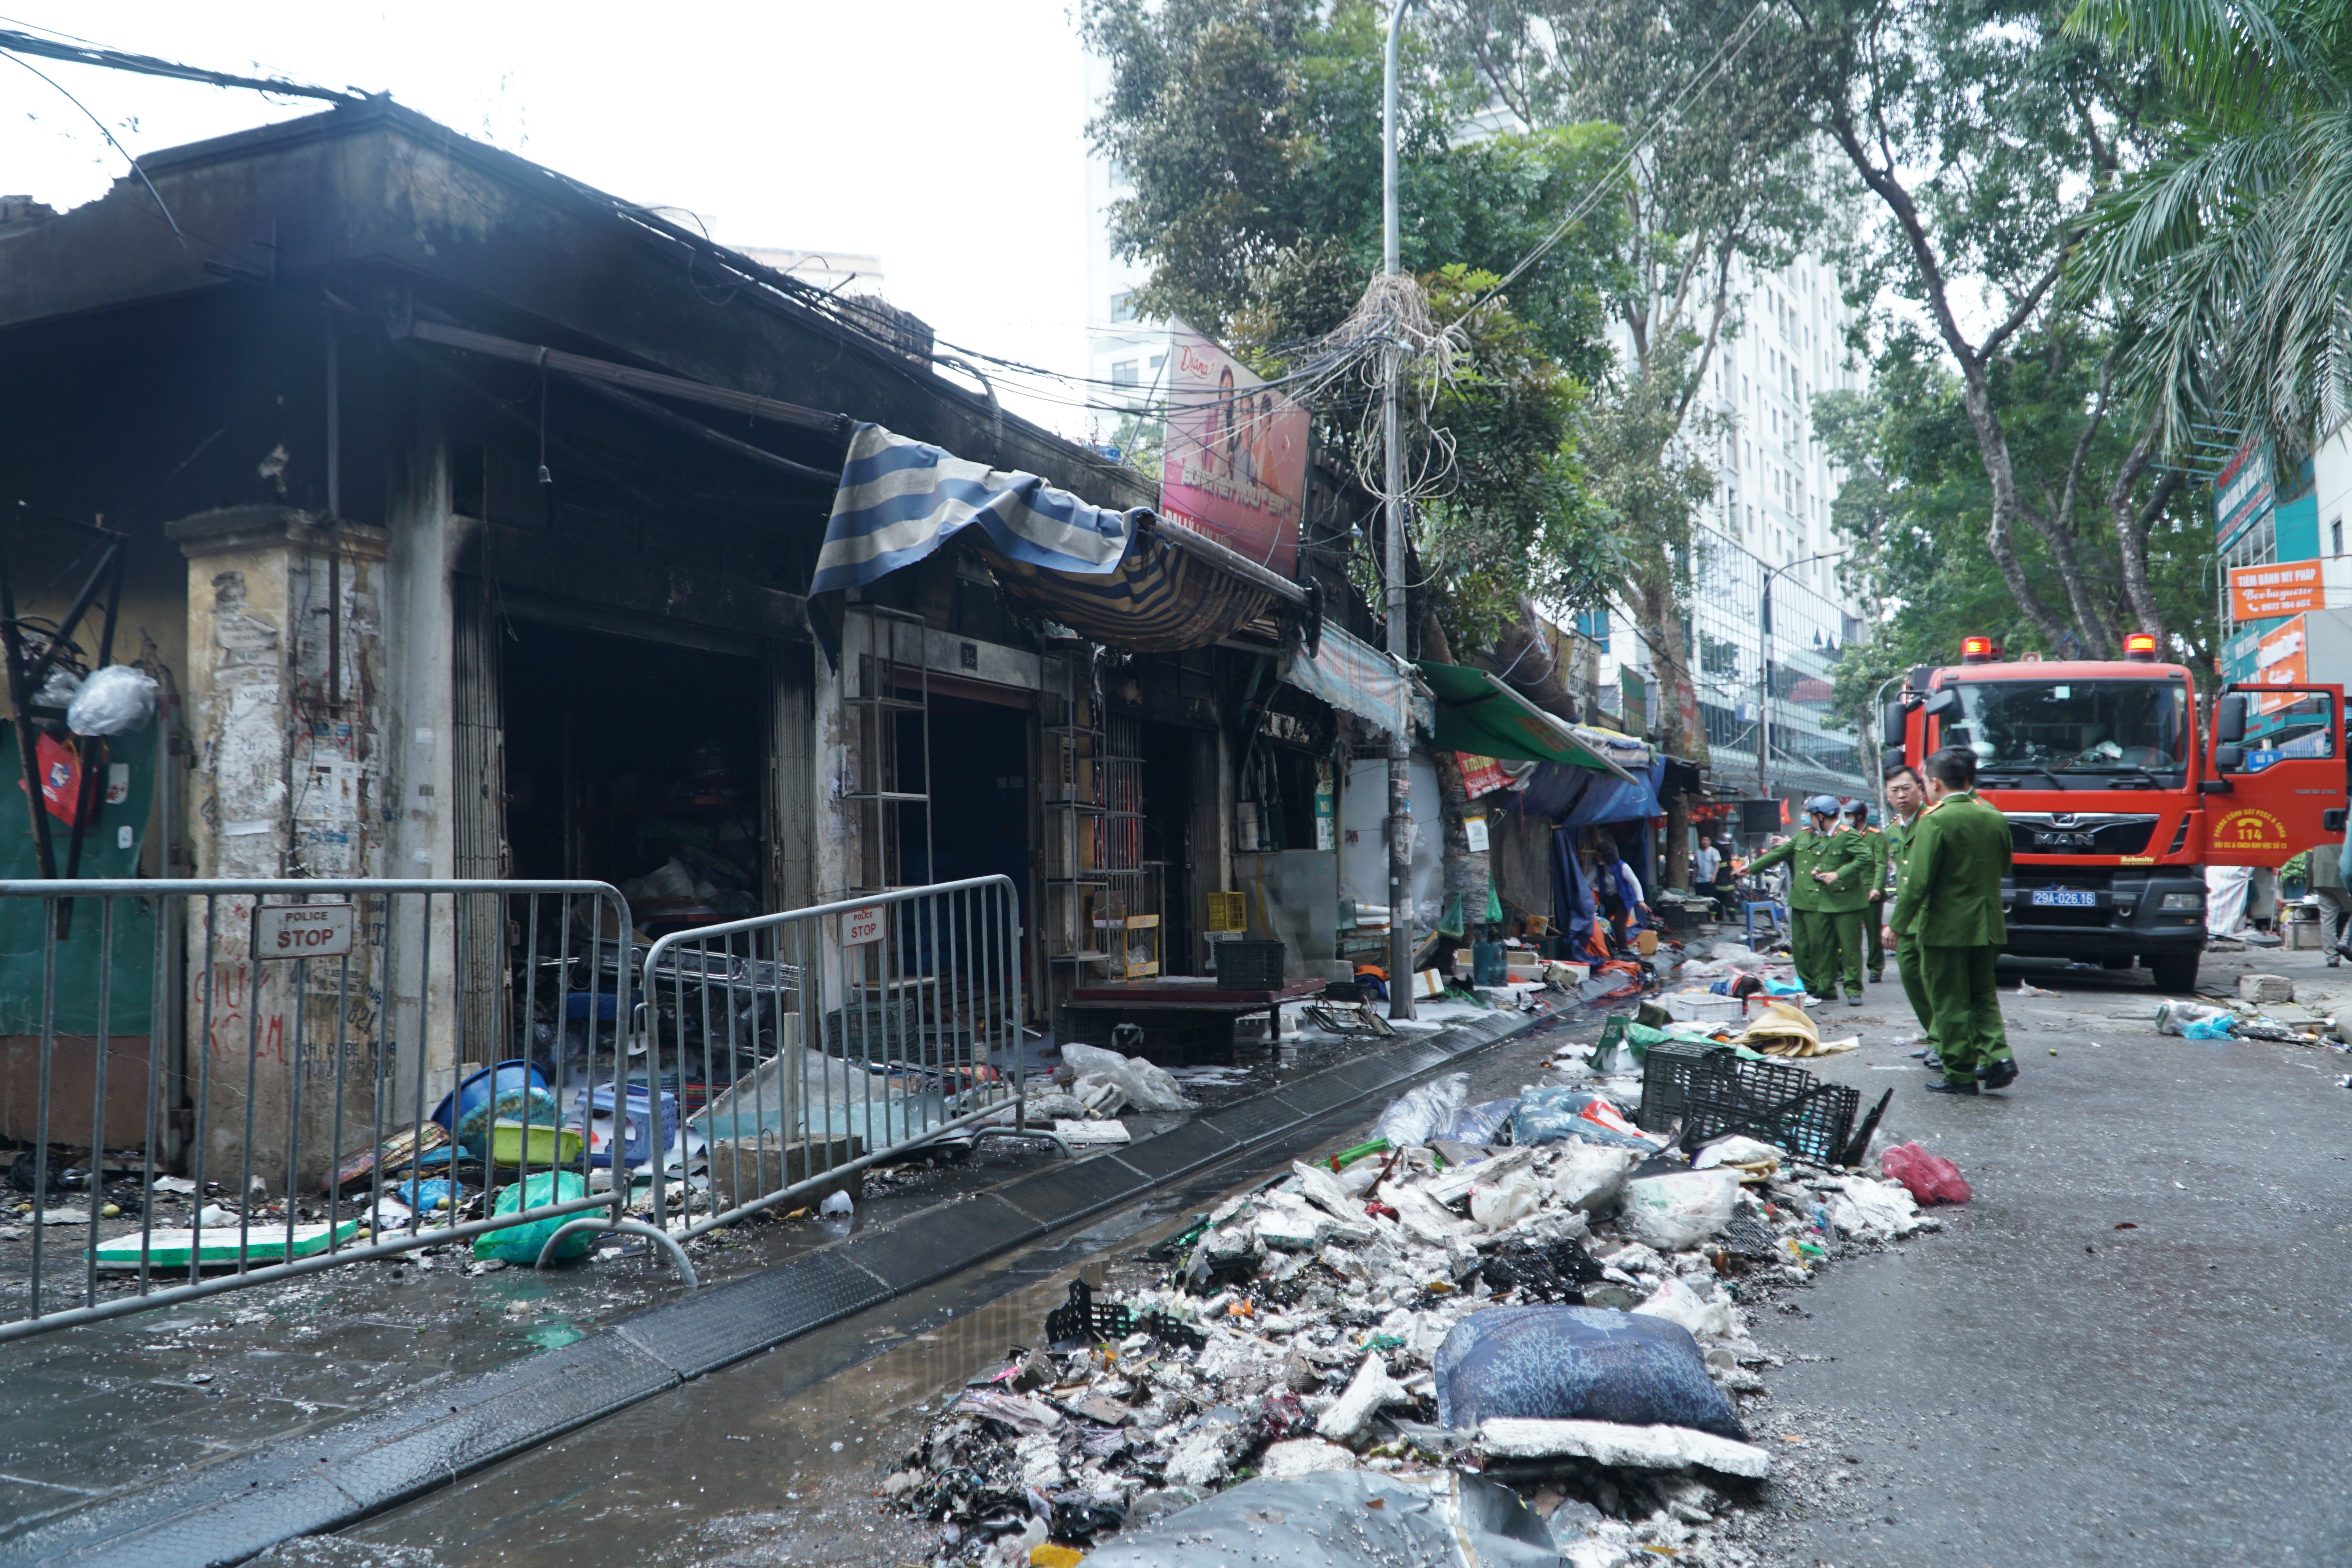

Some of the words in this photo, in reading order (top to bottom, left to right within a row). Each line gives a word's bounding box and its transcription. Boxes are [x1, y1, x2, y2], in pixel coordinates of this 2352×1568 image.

[1181, 345, 1209, 379] Diana
[2295, 567, 2316, 582] PHÁP
[2256, 809, 2272, 820] PCCC
[2034, 833, 2094, 846] MAN
[2238, 829, 2262, 840] 114
[2035, 892, 2094, 904] 29A-026.16
[285, 911, 328, 921] POLICE
[854, 911, 873, 921] POLICE
[851, 923, 876, 938] STOP
[278, 928, 334, 948] STOP
